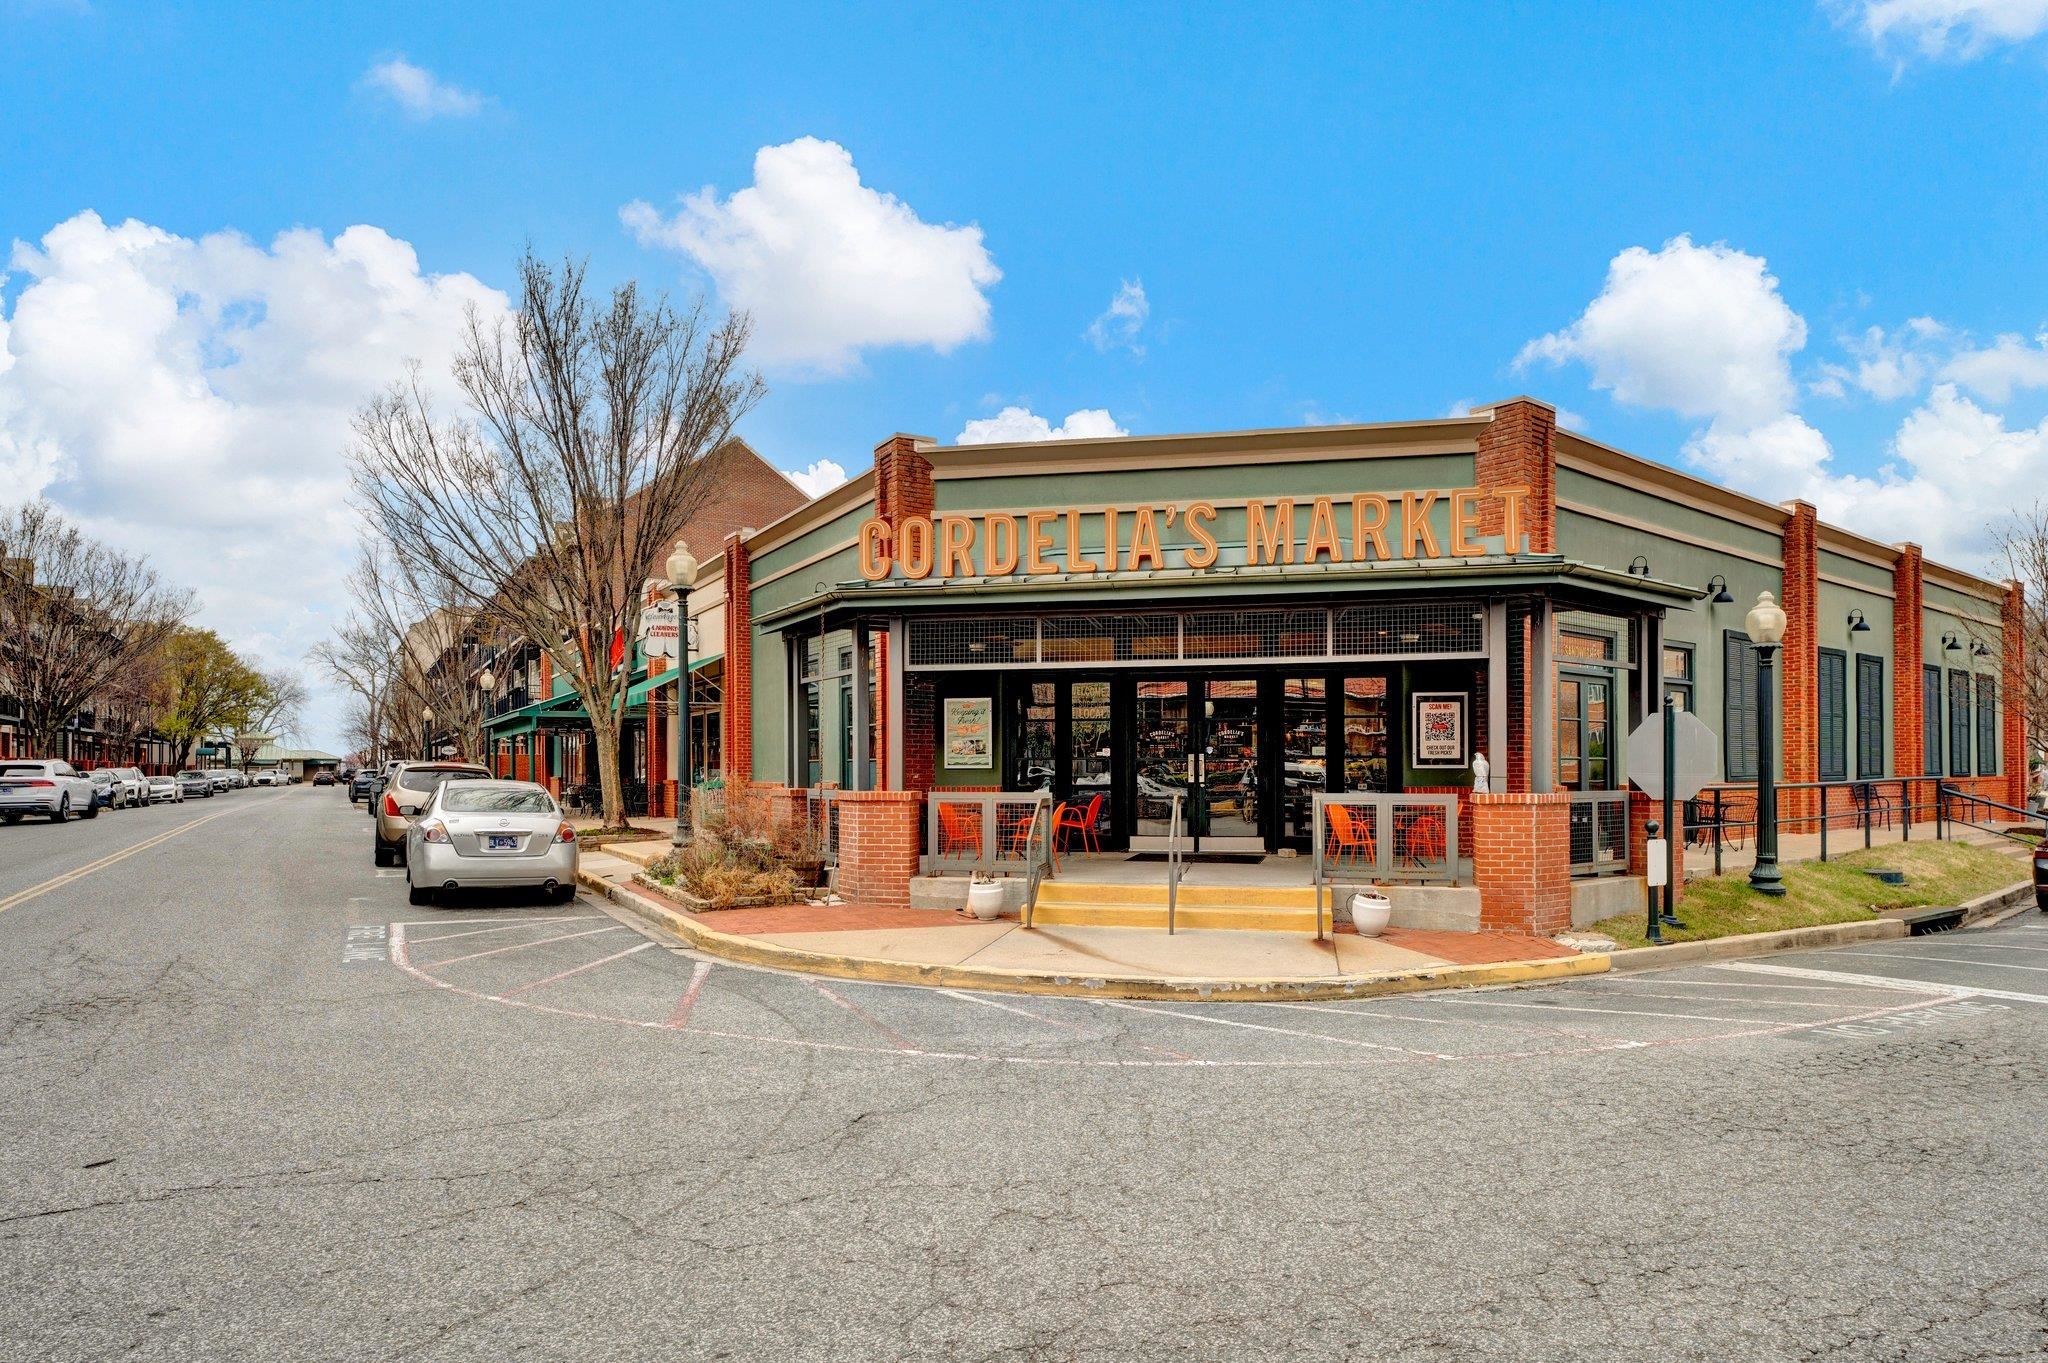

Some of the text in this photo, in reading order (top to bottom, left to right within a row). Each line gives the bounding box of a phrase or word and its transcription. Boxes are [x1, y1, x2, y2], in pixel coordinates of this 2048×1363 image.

[857, 485, 1532, 581] CORDELIA'S MARKET
[951, 706, 980, 717] Keeping
[957, 716, 981, 724] Fresh!
